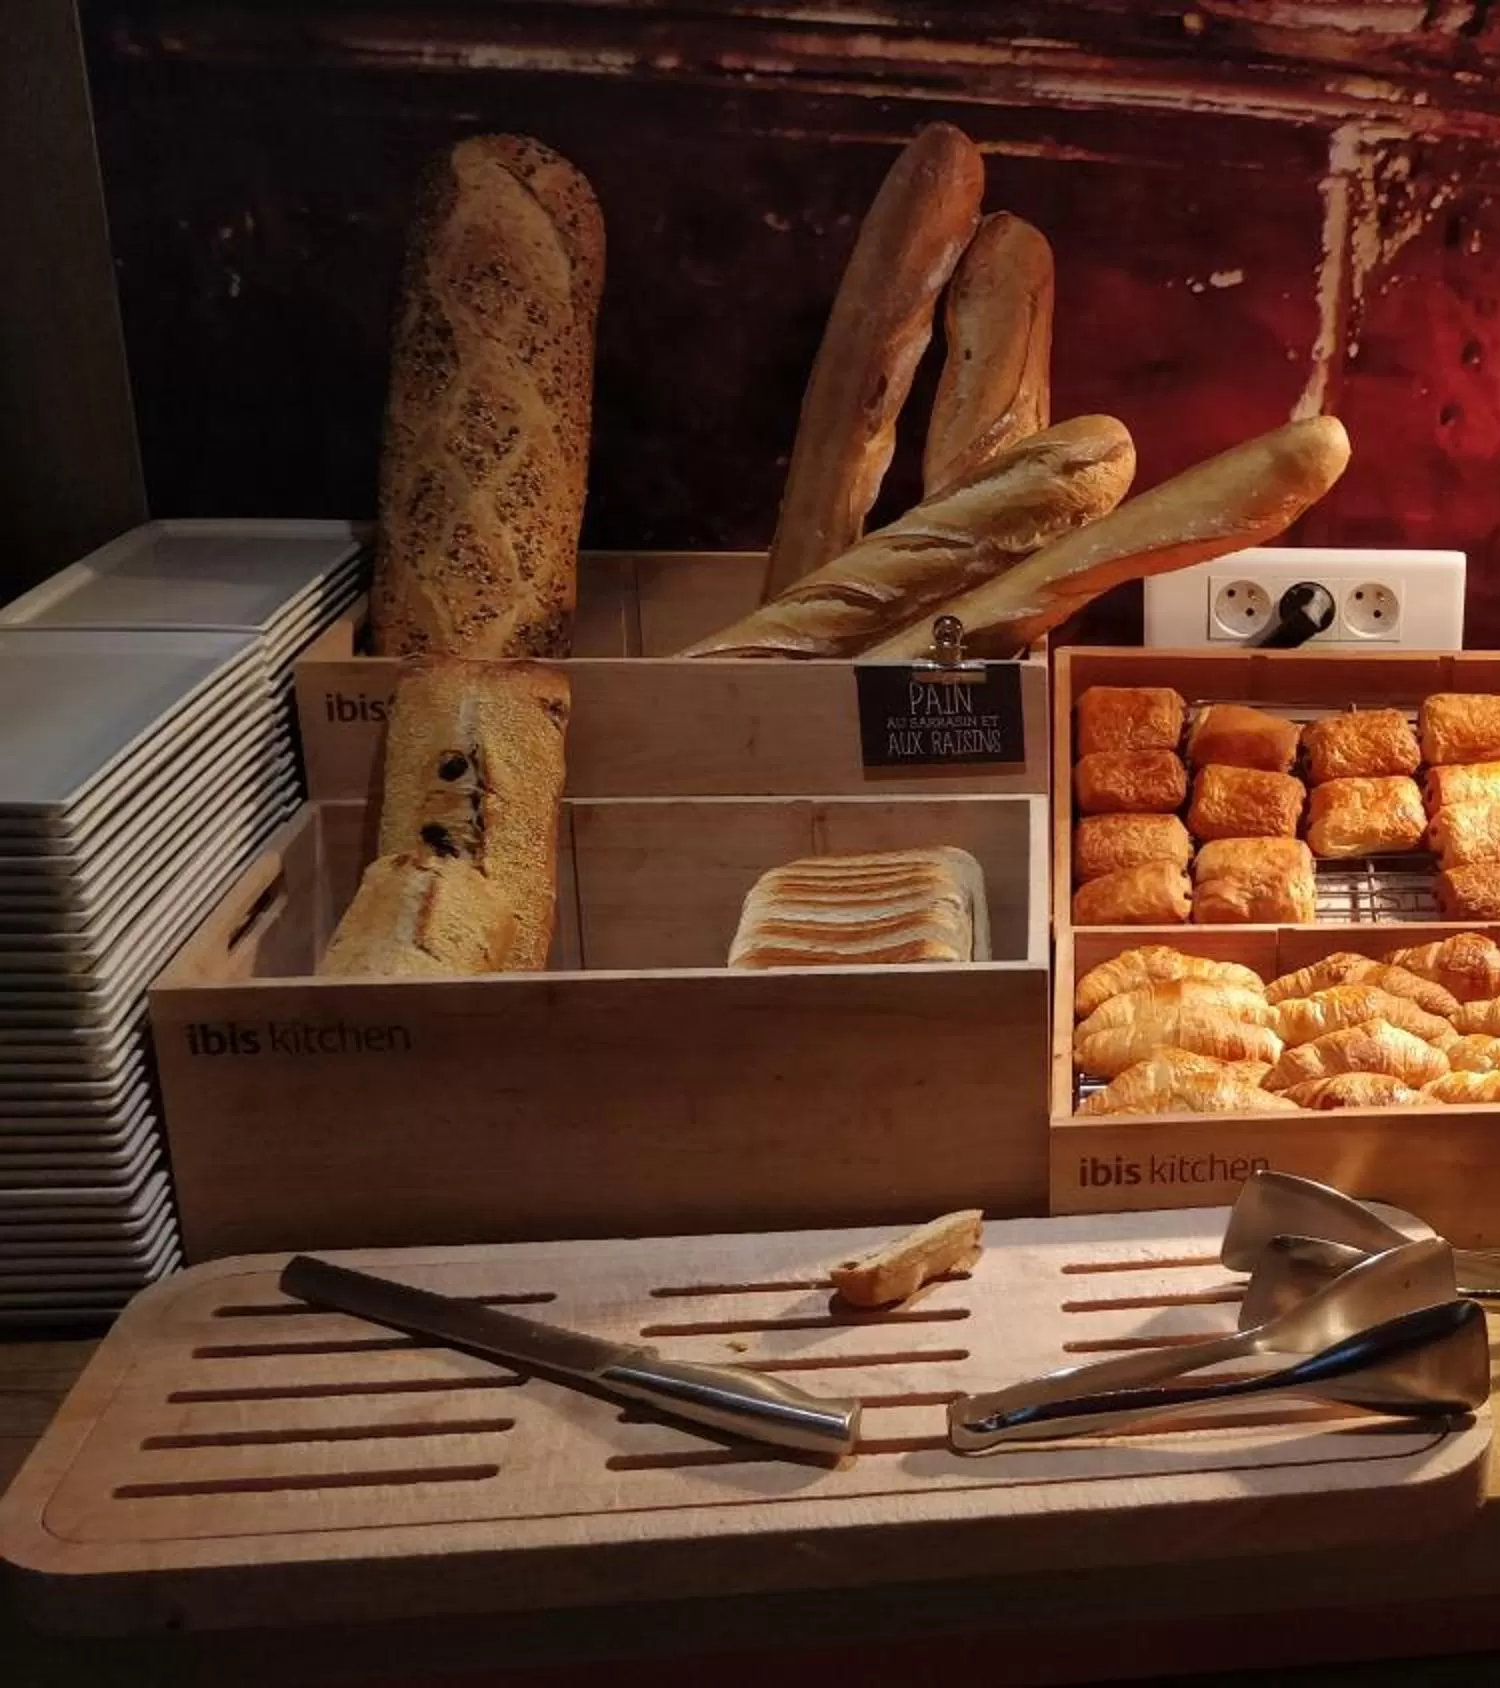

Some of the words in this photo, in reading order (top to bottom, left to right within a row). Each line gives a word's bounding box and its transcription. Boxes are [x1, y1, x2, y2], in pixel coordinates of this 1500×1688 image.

[325, 692, 387, 723] ibis
[908, 681, 972, 715] PAIN
[910, 715, 978, 729] SARRASIN
[981, 715, 1000, 728] ET
[888, 730, 926, 756] AUX
[931, 729, 1002, 755] RAISINS
[186, 1021, 262, 1056] ibis
[267, 1020, 412, 1054] kitchen
[1079, 1156, 1142, 1187] ibis
